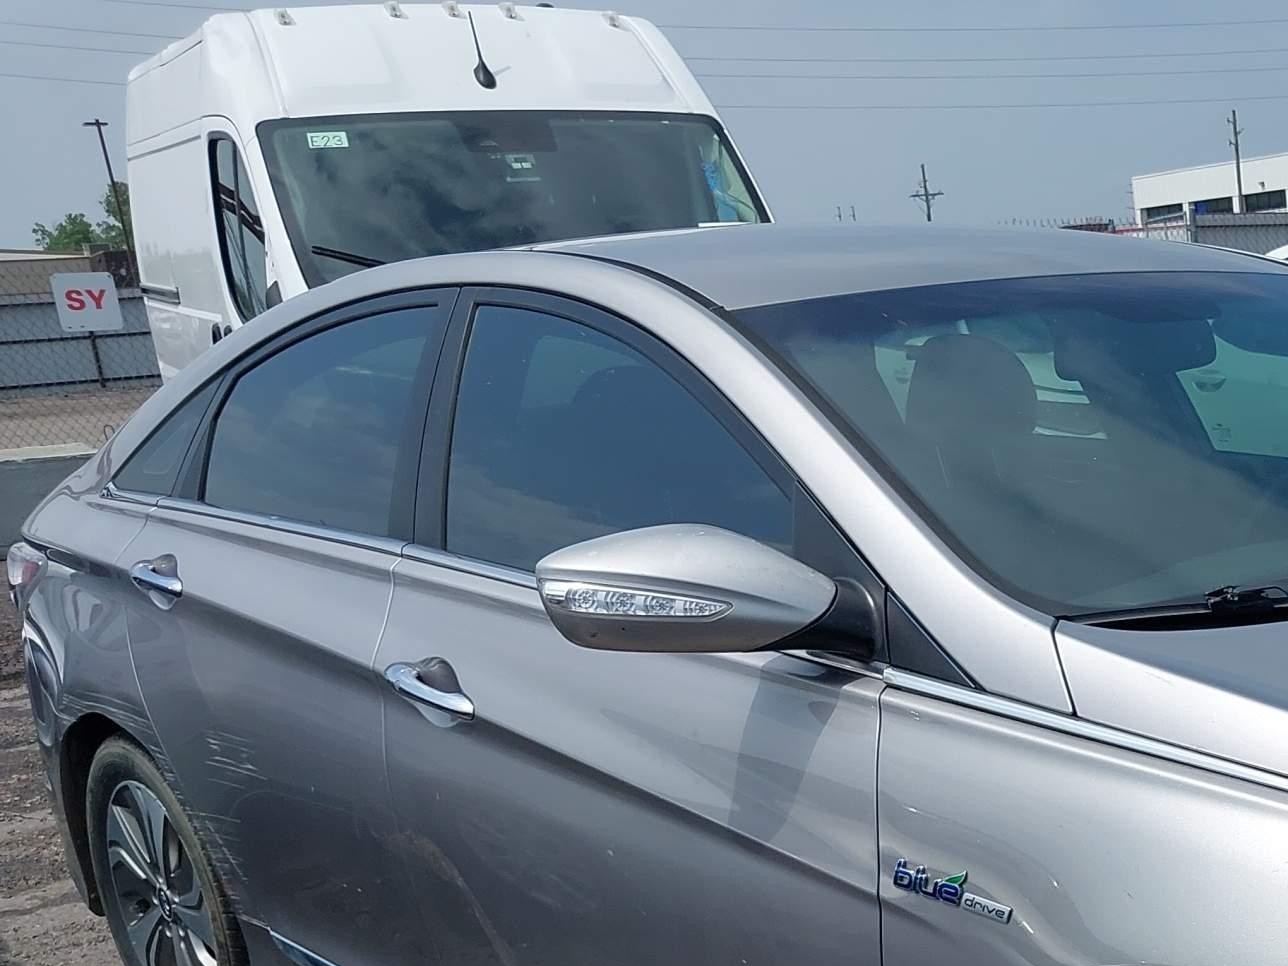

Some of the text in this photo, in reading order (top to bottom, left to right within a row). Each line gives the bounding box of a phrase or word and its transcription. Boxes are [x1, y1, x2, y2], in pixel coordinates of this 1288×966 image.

[310, 135, 344, 147] E23
[64, 289, 106, 311] SY
[893, 857, 1006, 919] blue drive
